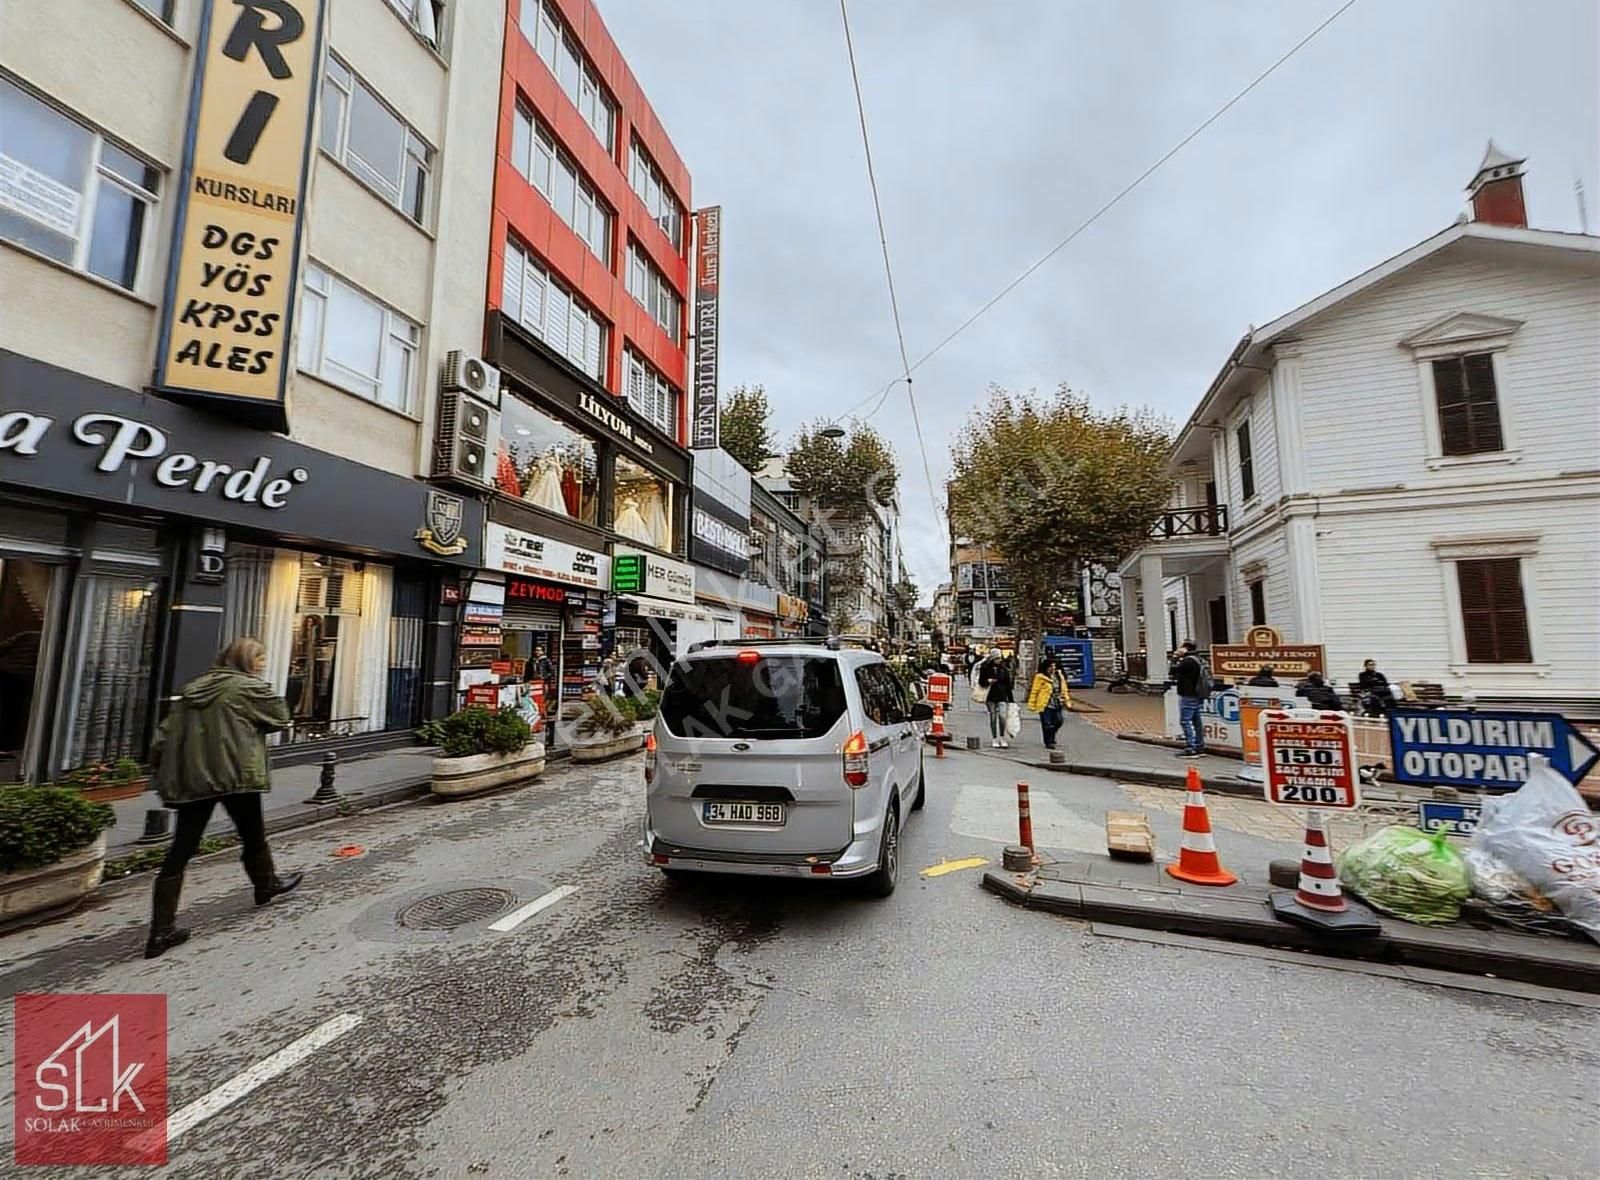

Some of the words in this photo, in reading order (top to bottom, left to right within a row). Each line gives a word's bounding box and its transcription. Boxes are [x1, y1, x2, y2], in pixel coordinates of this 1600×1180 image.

[195, 176, 296, 215] KURSLARI
[202, 224, 279, 260] DGS
[200, 263, 272, 297] YÖS
[701, 262, 717, 287] Kurs
[180, 299, 279, 337] KPSS
[175, 339, 274, 375] ALES
[700, 408, 716, 441] FEN
[508, 582, 564, 601] ZEYMOD
[1267, 724, 1302, 733] FOR
[1306, 725, 1347, 734] MEN
[1395, 717, 1555, 748] YILDIRIM
[1277, 749, 1333, 764] 150
[1283, 786, 1337, 802] 200
[711, 804, 726, 819] 34
[730, 805, 753, 820] HAD
[757, 805, 780, 820] 968
